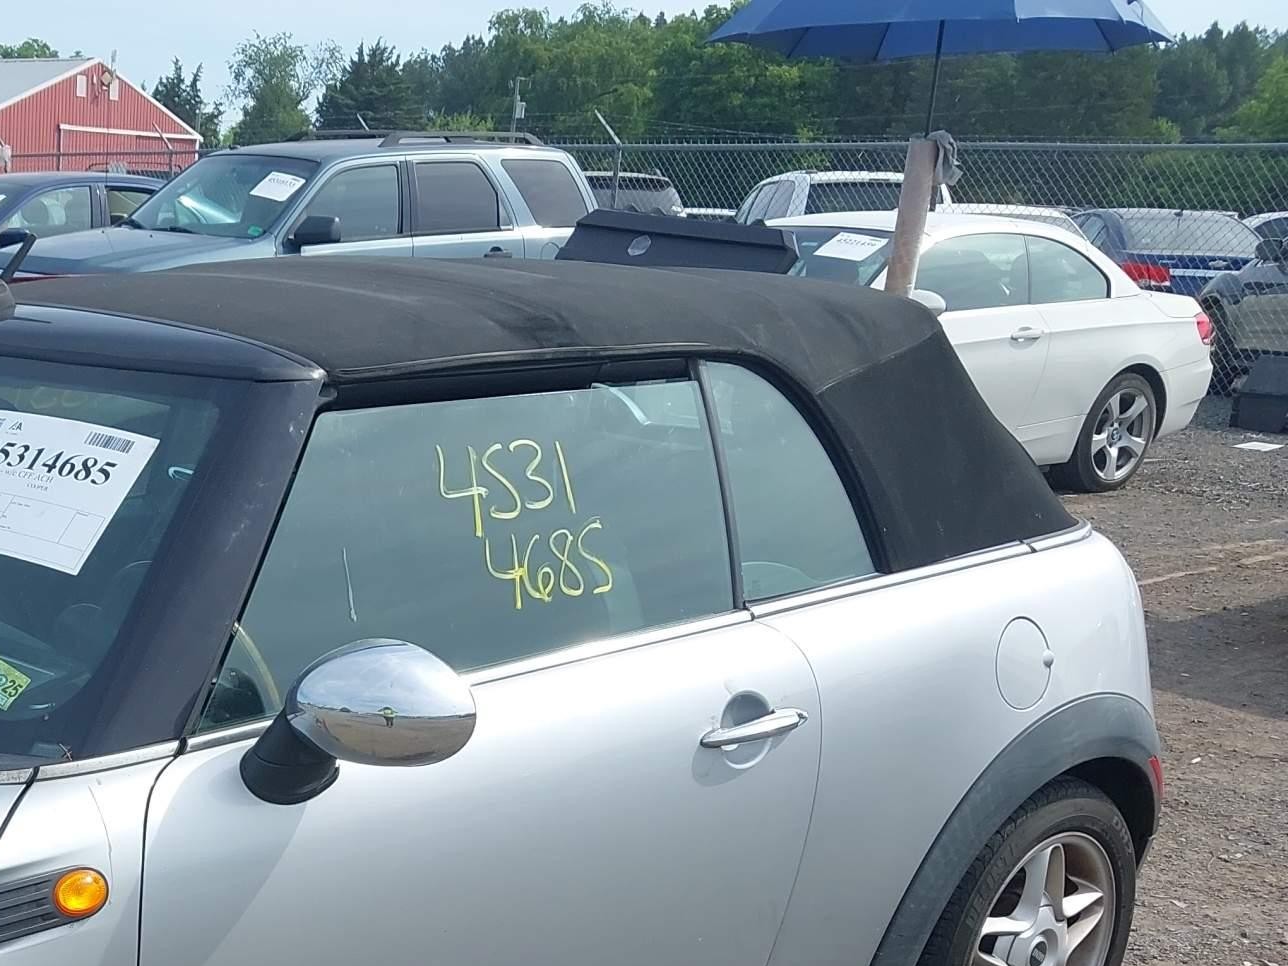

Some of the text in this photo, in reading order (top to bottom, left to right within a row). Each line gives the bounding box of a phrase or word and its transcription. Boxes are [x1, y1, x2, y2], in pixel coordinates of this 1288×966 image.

[435, 438, 577, 537] 4531
[485, 516, 613, 610] 4685
[1, 679, 23, 698] 25
